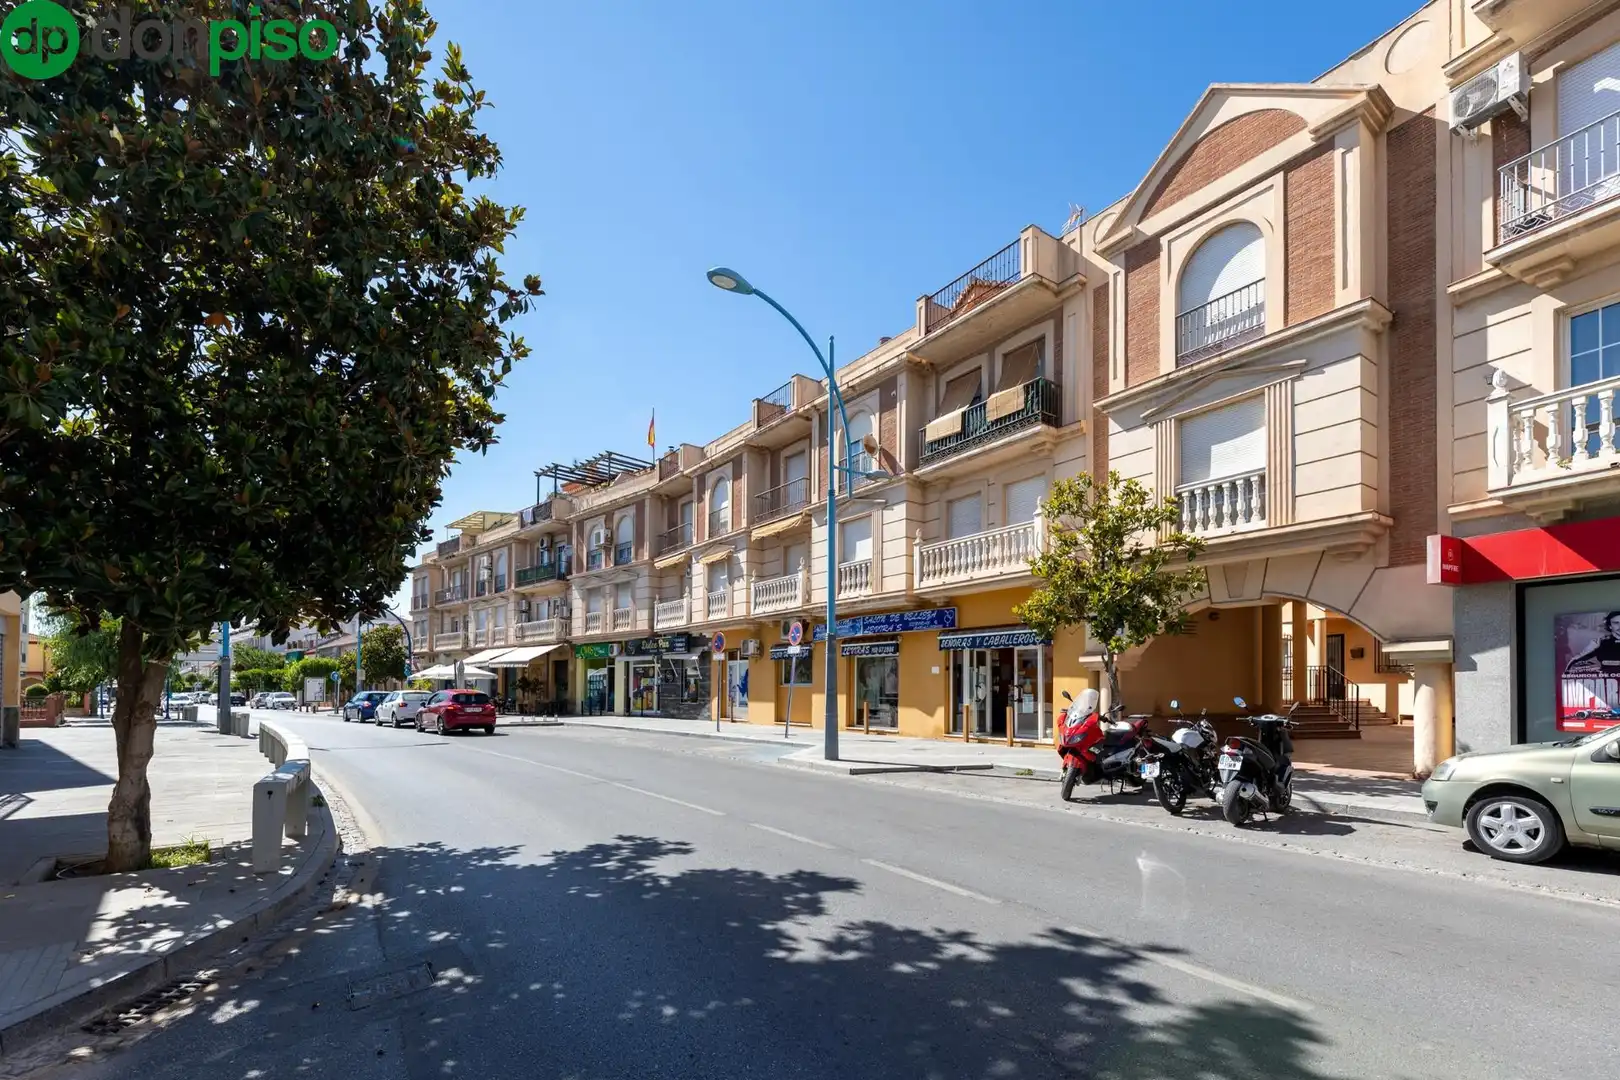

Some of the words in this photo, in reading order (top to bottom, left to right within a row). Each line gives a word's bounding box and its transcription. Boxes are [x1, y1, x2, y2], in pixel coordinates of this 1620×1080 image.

[890, 613, 901, 623] DE
[976, 637, 983, 646] Y
[983, 633, 1036, 646] CABALLEROS
